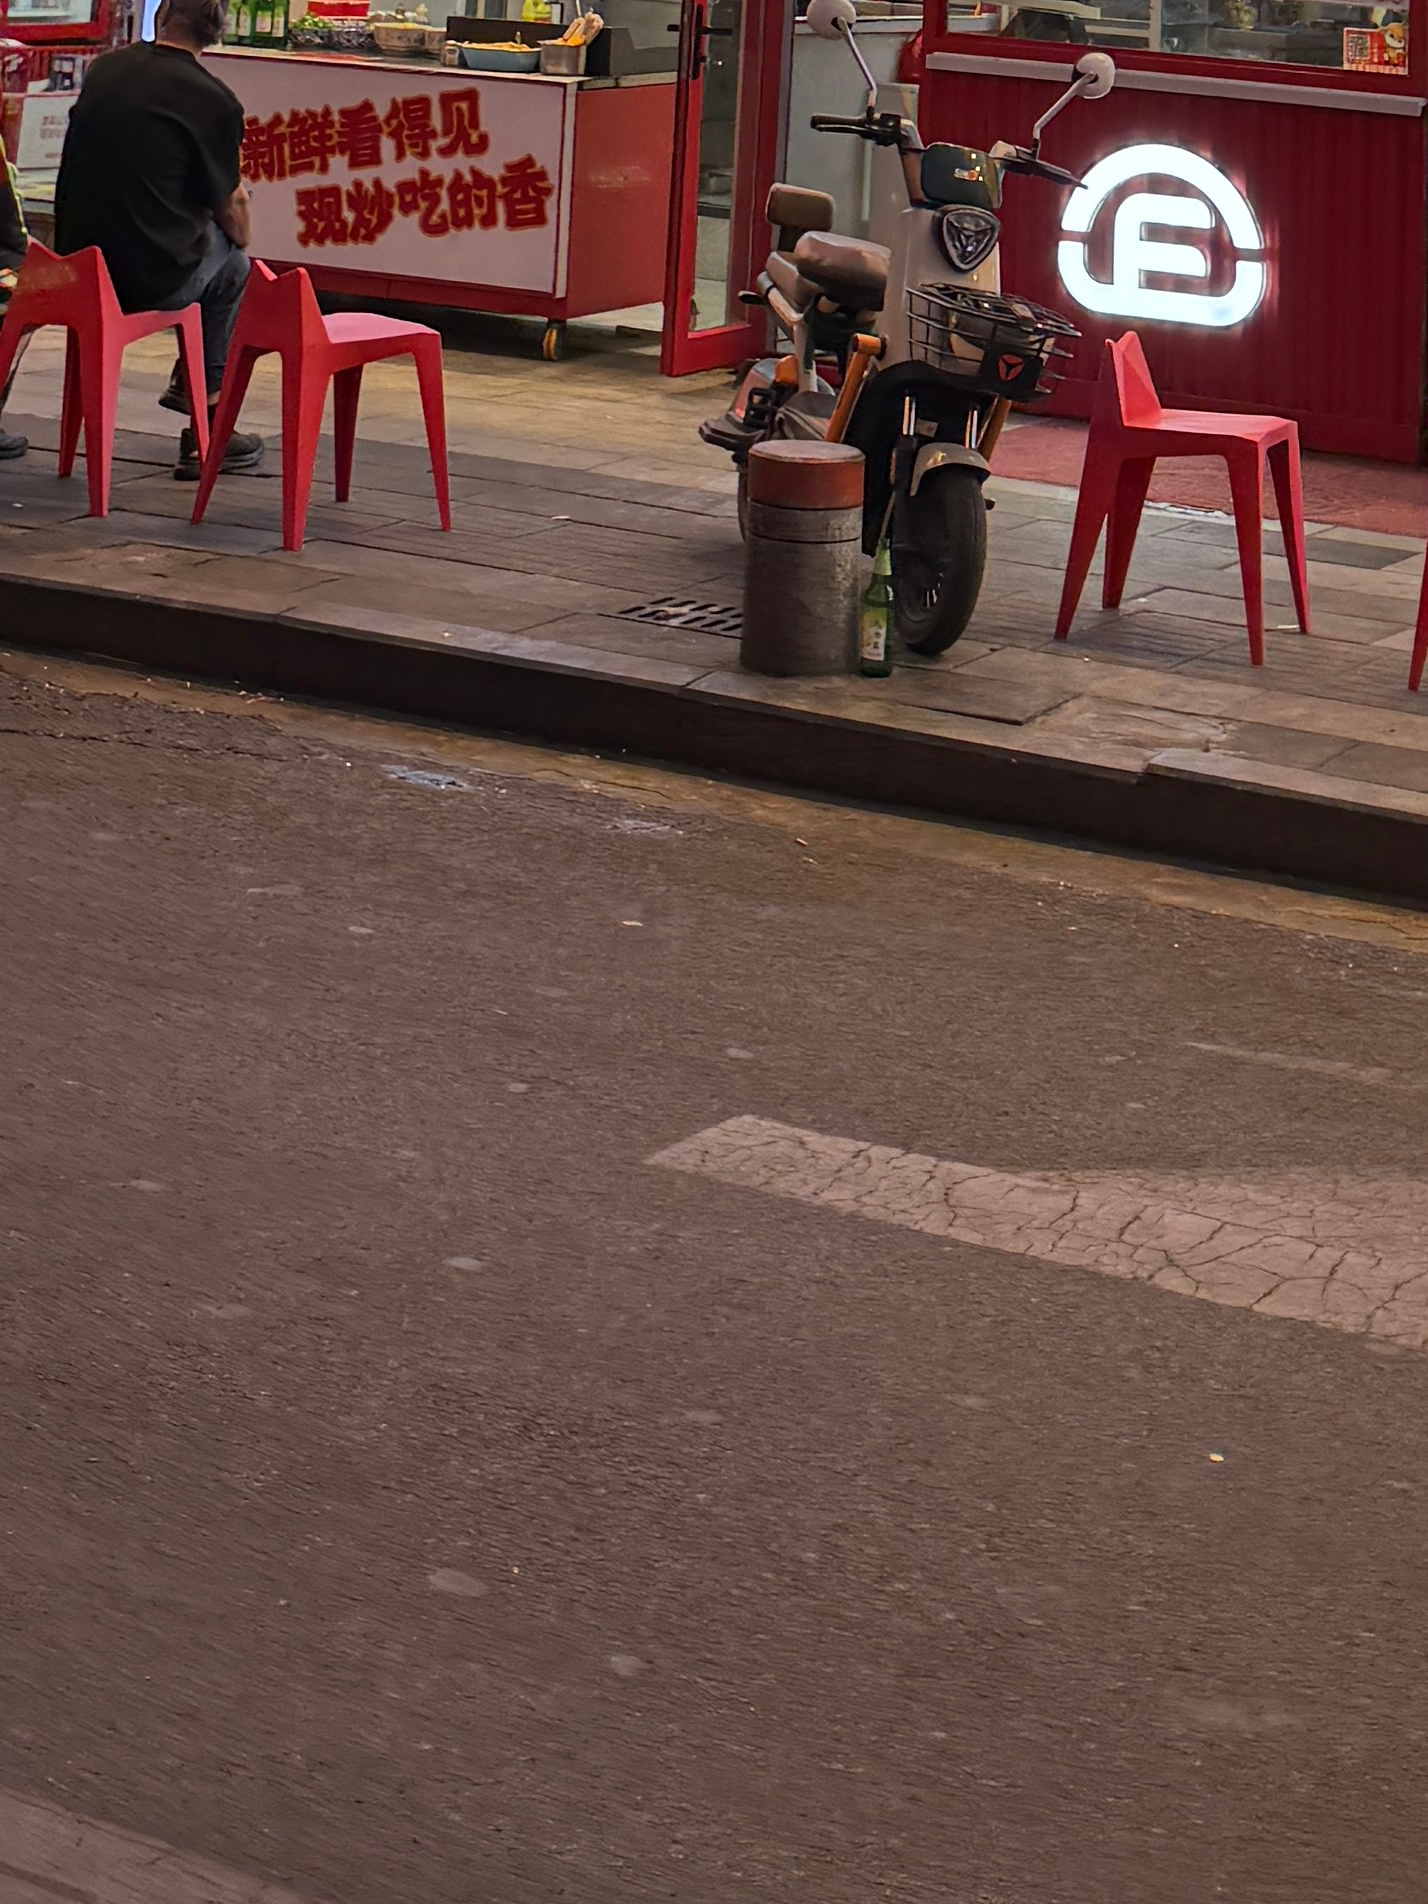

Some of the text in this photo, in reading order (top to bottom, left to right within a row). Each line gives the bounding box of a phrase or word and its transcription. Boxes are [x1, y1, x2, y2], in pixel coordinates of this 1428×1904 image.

[240, 87, 489, 182] 新鲜看得见
[296, 153, 554, 248] 现炒吃的香
